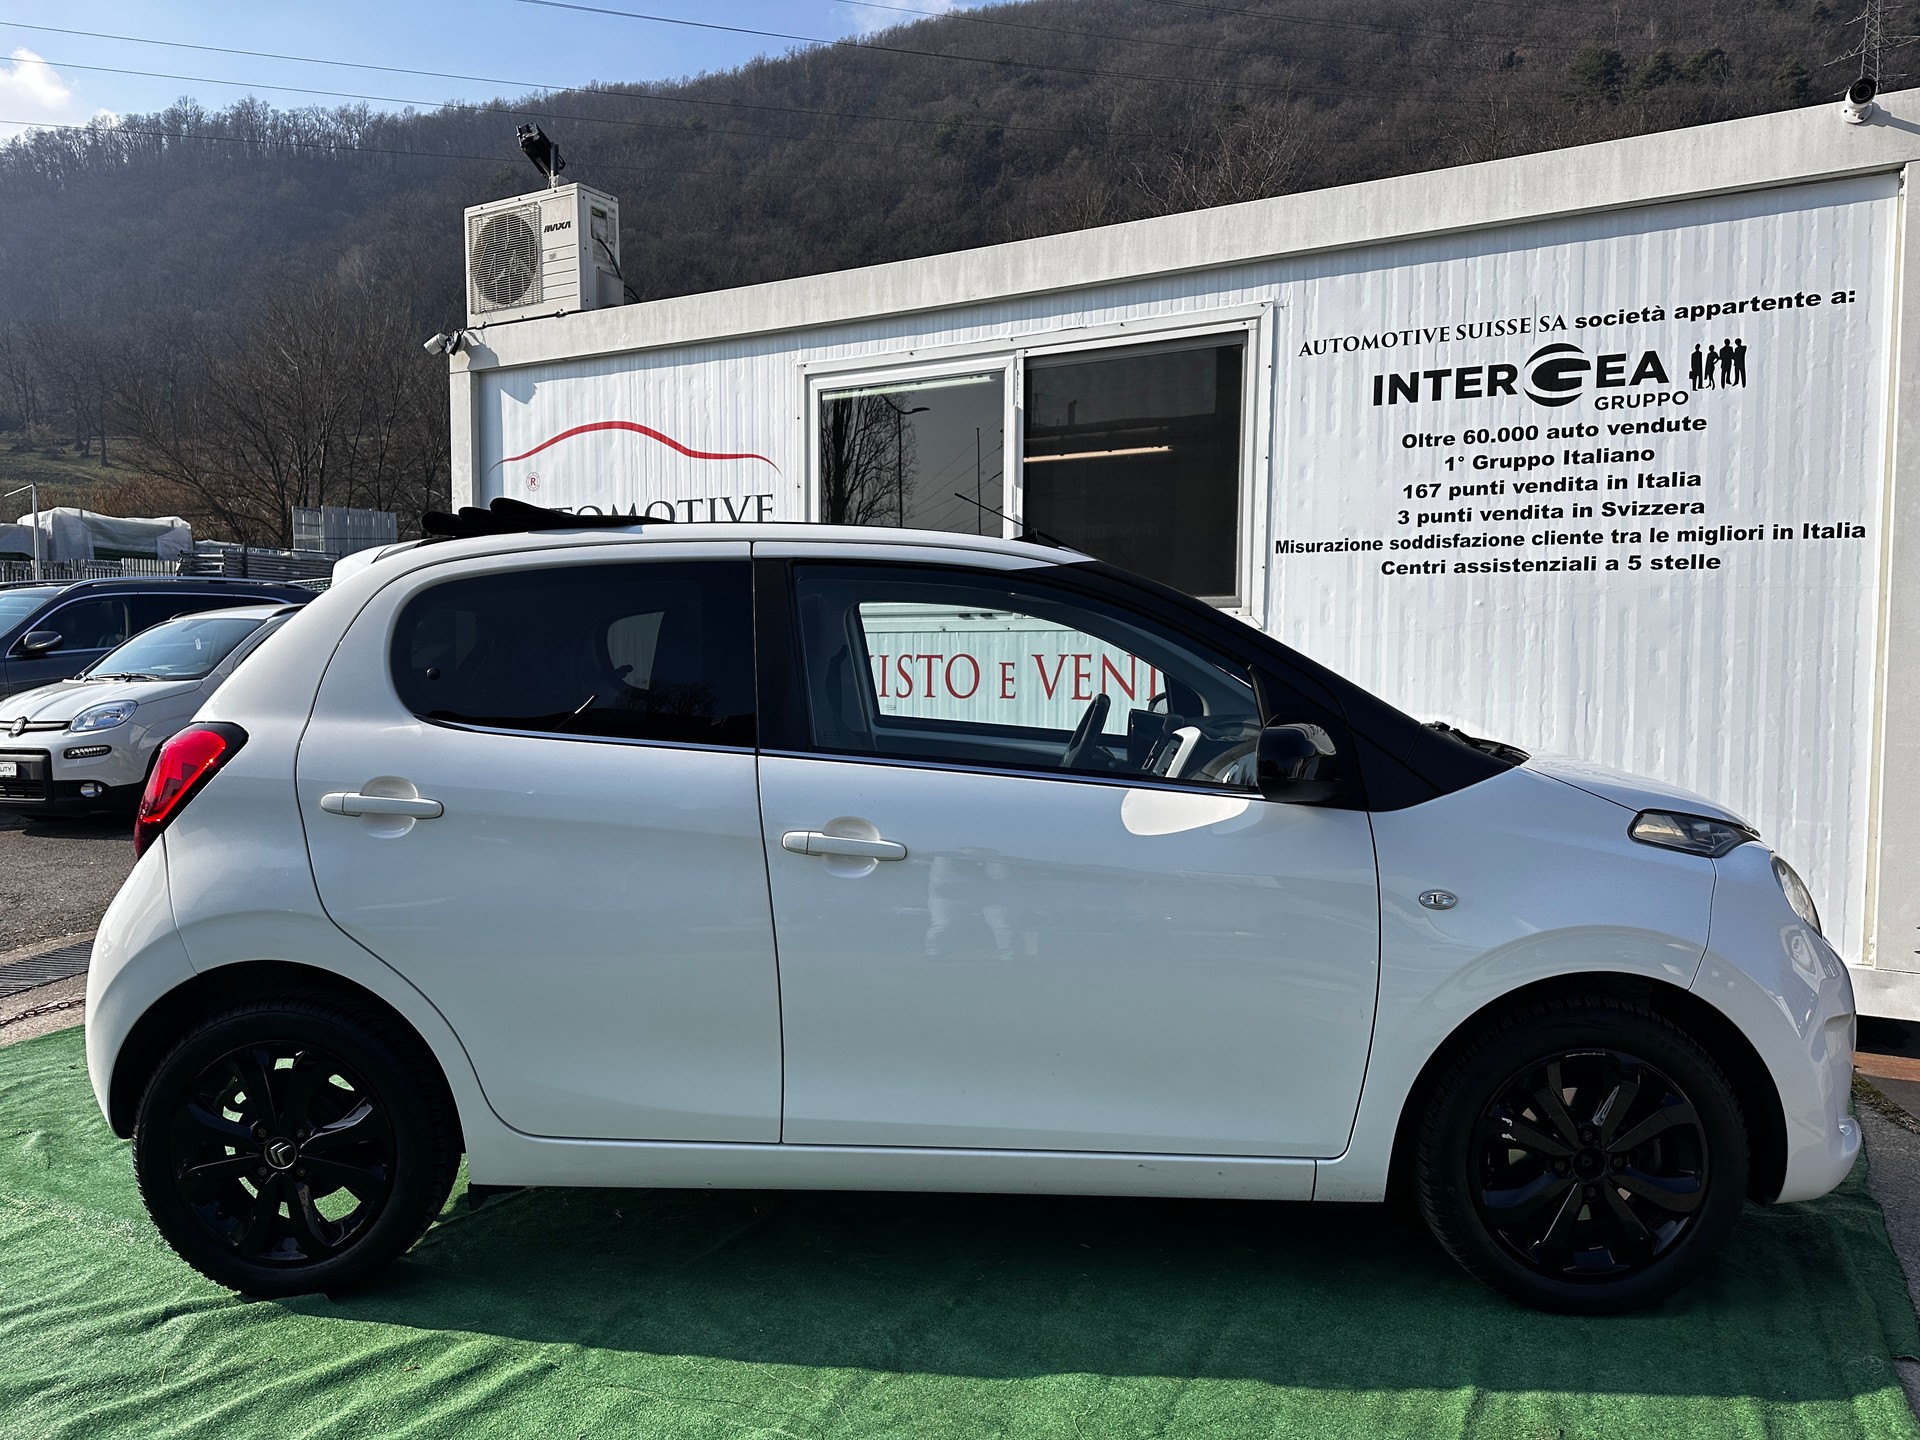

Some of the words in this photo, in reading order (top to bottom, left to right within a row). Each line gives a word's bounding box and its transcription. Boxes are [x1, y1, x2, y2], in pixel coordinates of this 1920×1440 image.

[543, 220, 572, 234] MAXA
[1298, 326, 1450, 357] AUTOMOTIVE
[1455, 317, 1532, 341] SUISSE
[1538, 314, 1568, 333] SA
[1574, 304, 1666, 329] società
[1674, 291, 1822, 322] appartente
[1830, 290, 1856, 305] a:
[1594, 390, 1689, 411] GRUPPO
[1401, 432, 1456, 449] Oltre
[1463, 425, 1539, 445] 60.000
[1546, 422, 1600, 440] auto
[1606, 415, 1708, 436] vendute
[1444, 455, 1465, 472] 1°
[1472, 454, 1555, 472] Gruppo
[1563, 447, 1655, 466] Italiano
[1403, 482, 1442, 500] 167
[1448, 479, 1505, 501] punti
[1512, 476, 1599, 494] vendita
[1607, 474, 1628, 490] in
[1637, 471, 1702, 489] Italia
[1397, 510, 1410, 525] 3
[1417, 507, 1473, 528] punti
[1479, 504, 1564, 522] vendita
[1572, 502, 1593, 518] in
[1601, 500, 1705, 518] Svizzera
[1275, 537, 1384, 554] Misurazione
[1389, 532, 1525, 551] soddisfazione
[1531, 529, 1604, 546] cliente
[1610, 528, 1642, 544] tra
[1649, 527, 1670, 543] le
[1677, 524, 1764, 546] migliori
[1772, 523, 1794, 540] in
[1802, 521, 1866, 540] Italia
[1381, 559, 1446, 576] Centri
[1453, 555, 1597, 574] assistenziali
[1604, 559, 1619, 571] a
[1627, 554, 1642, 571] 5
[1650, 553, 1721, 571] stelle
[869, 653, 981, 699] ISTO
[999, 661, 1016, 699] E
